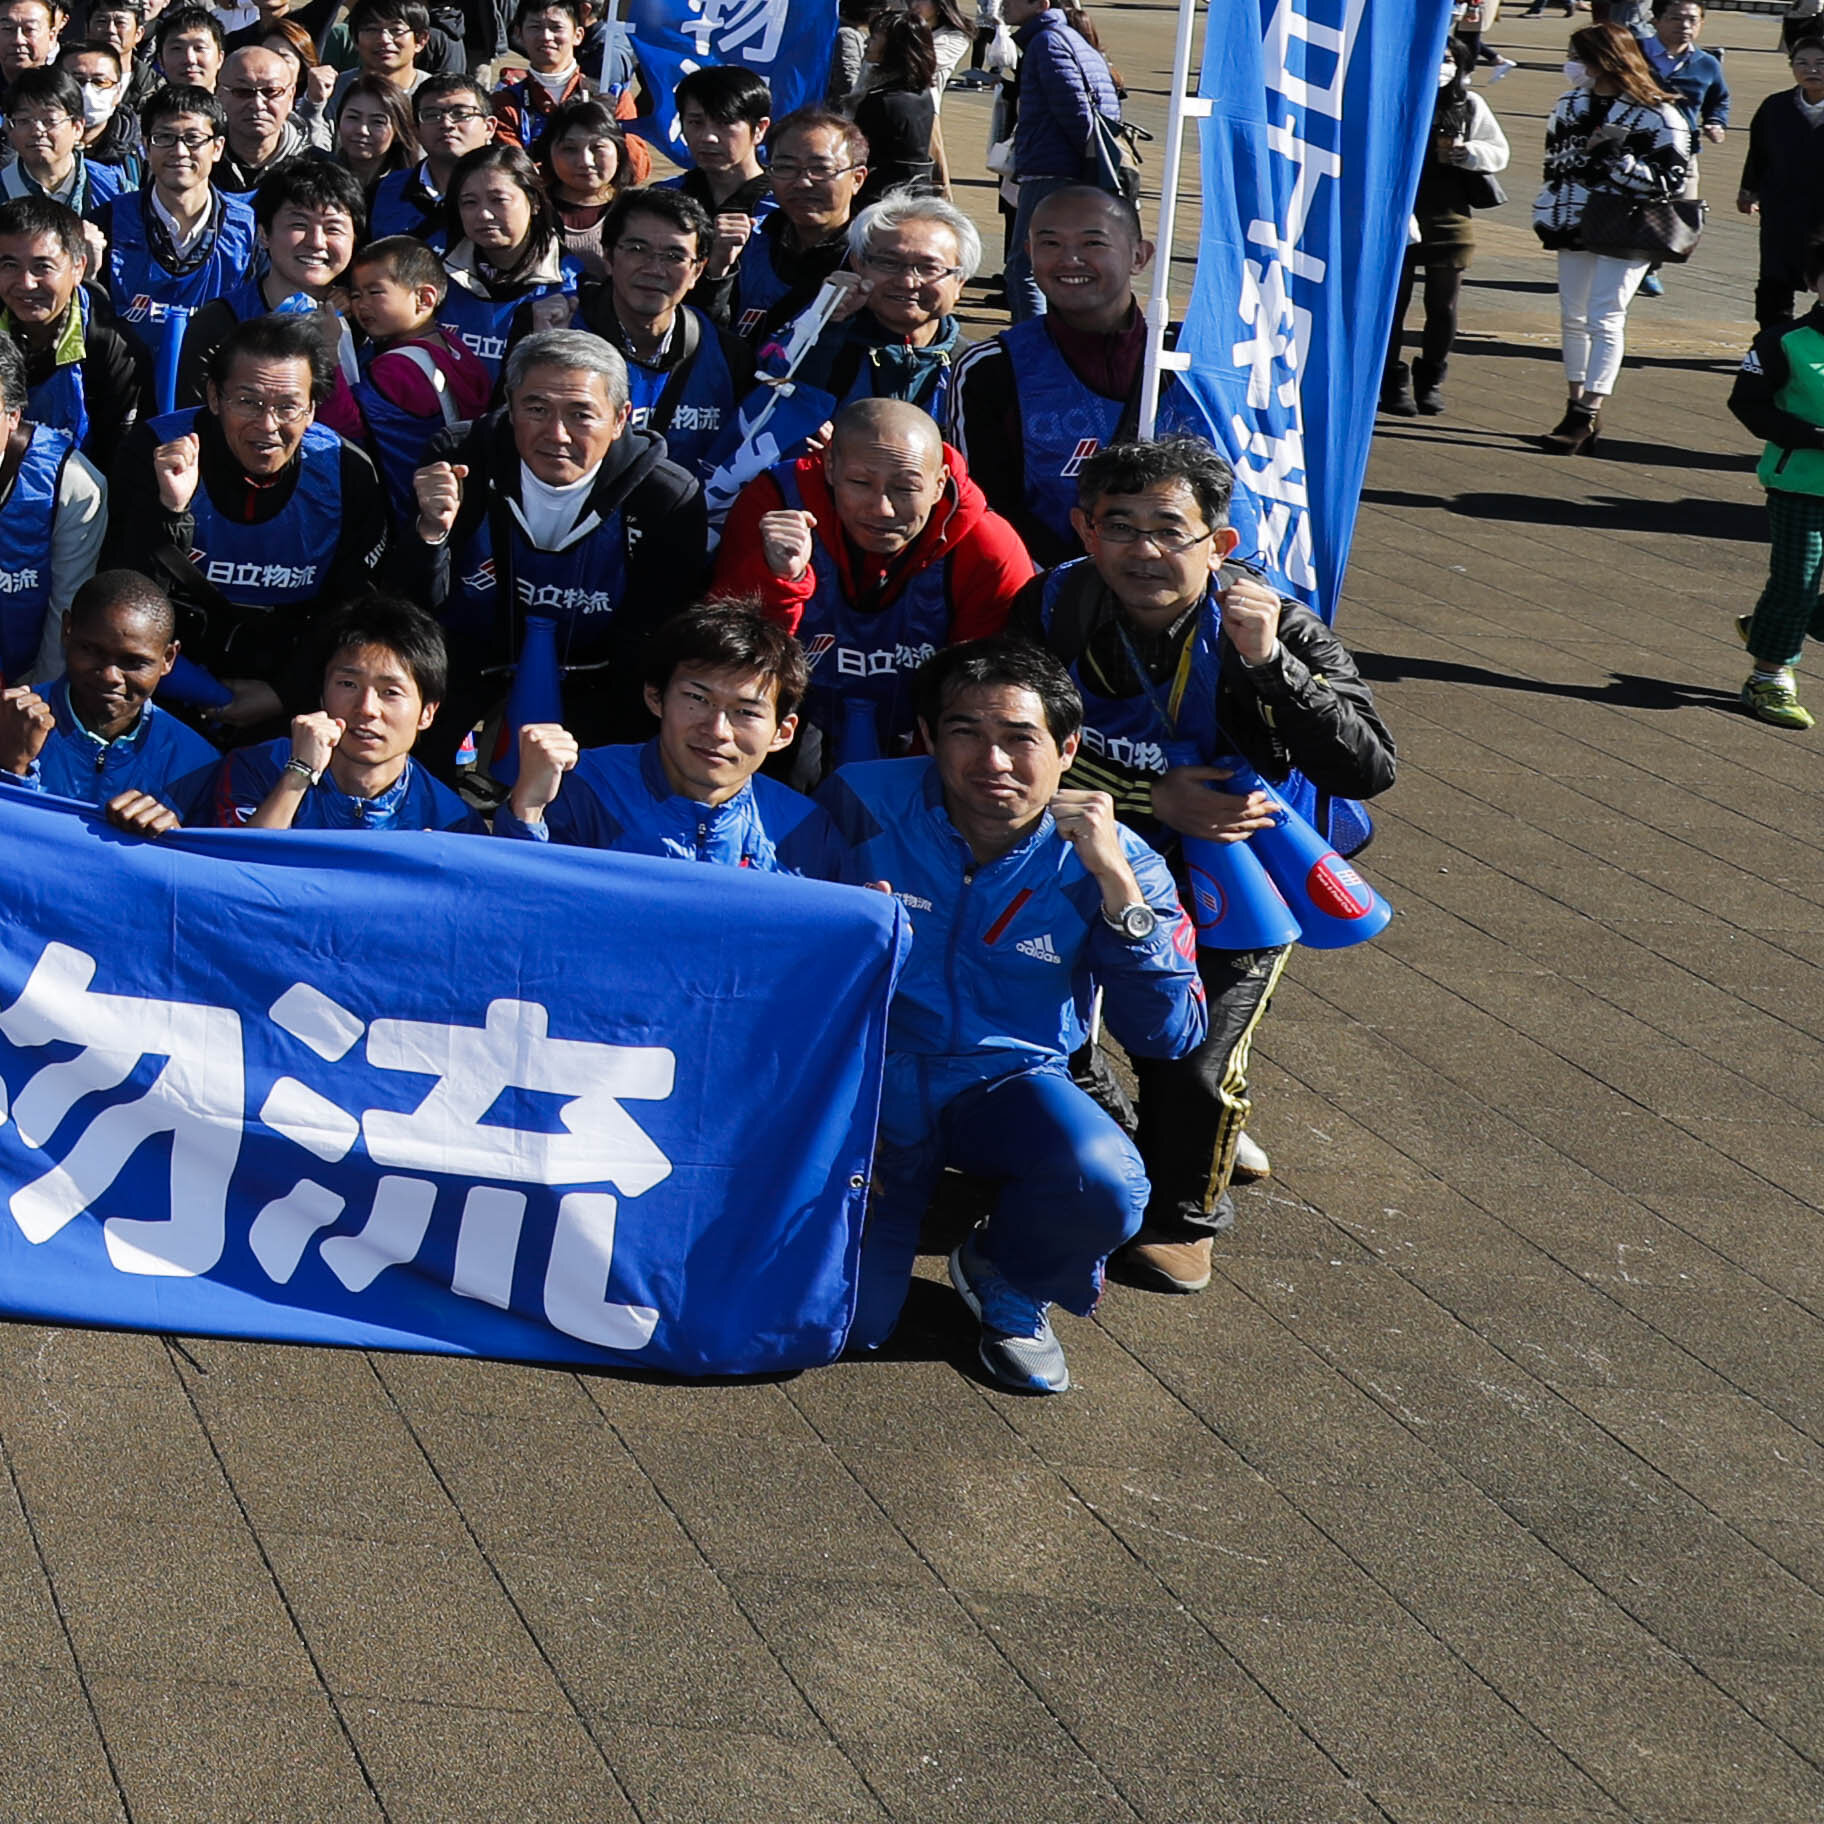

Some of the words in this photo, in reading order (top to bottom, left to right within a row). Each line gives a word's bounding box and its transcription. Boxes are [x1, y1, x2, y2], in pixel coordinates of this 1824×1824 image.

[207, 561, 316, 587] 日立物流
[516, 577, 613, 614] 日立物流
[1016, 942, 1061, 964] adidas
